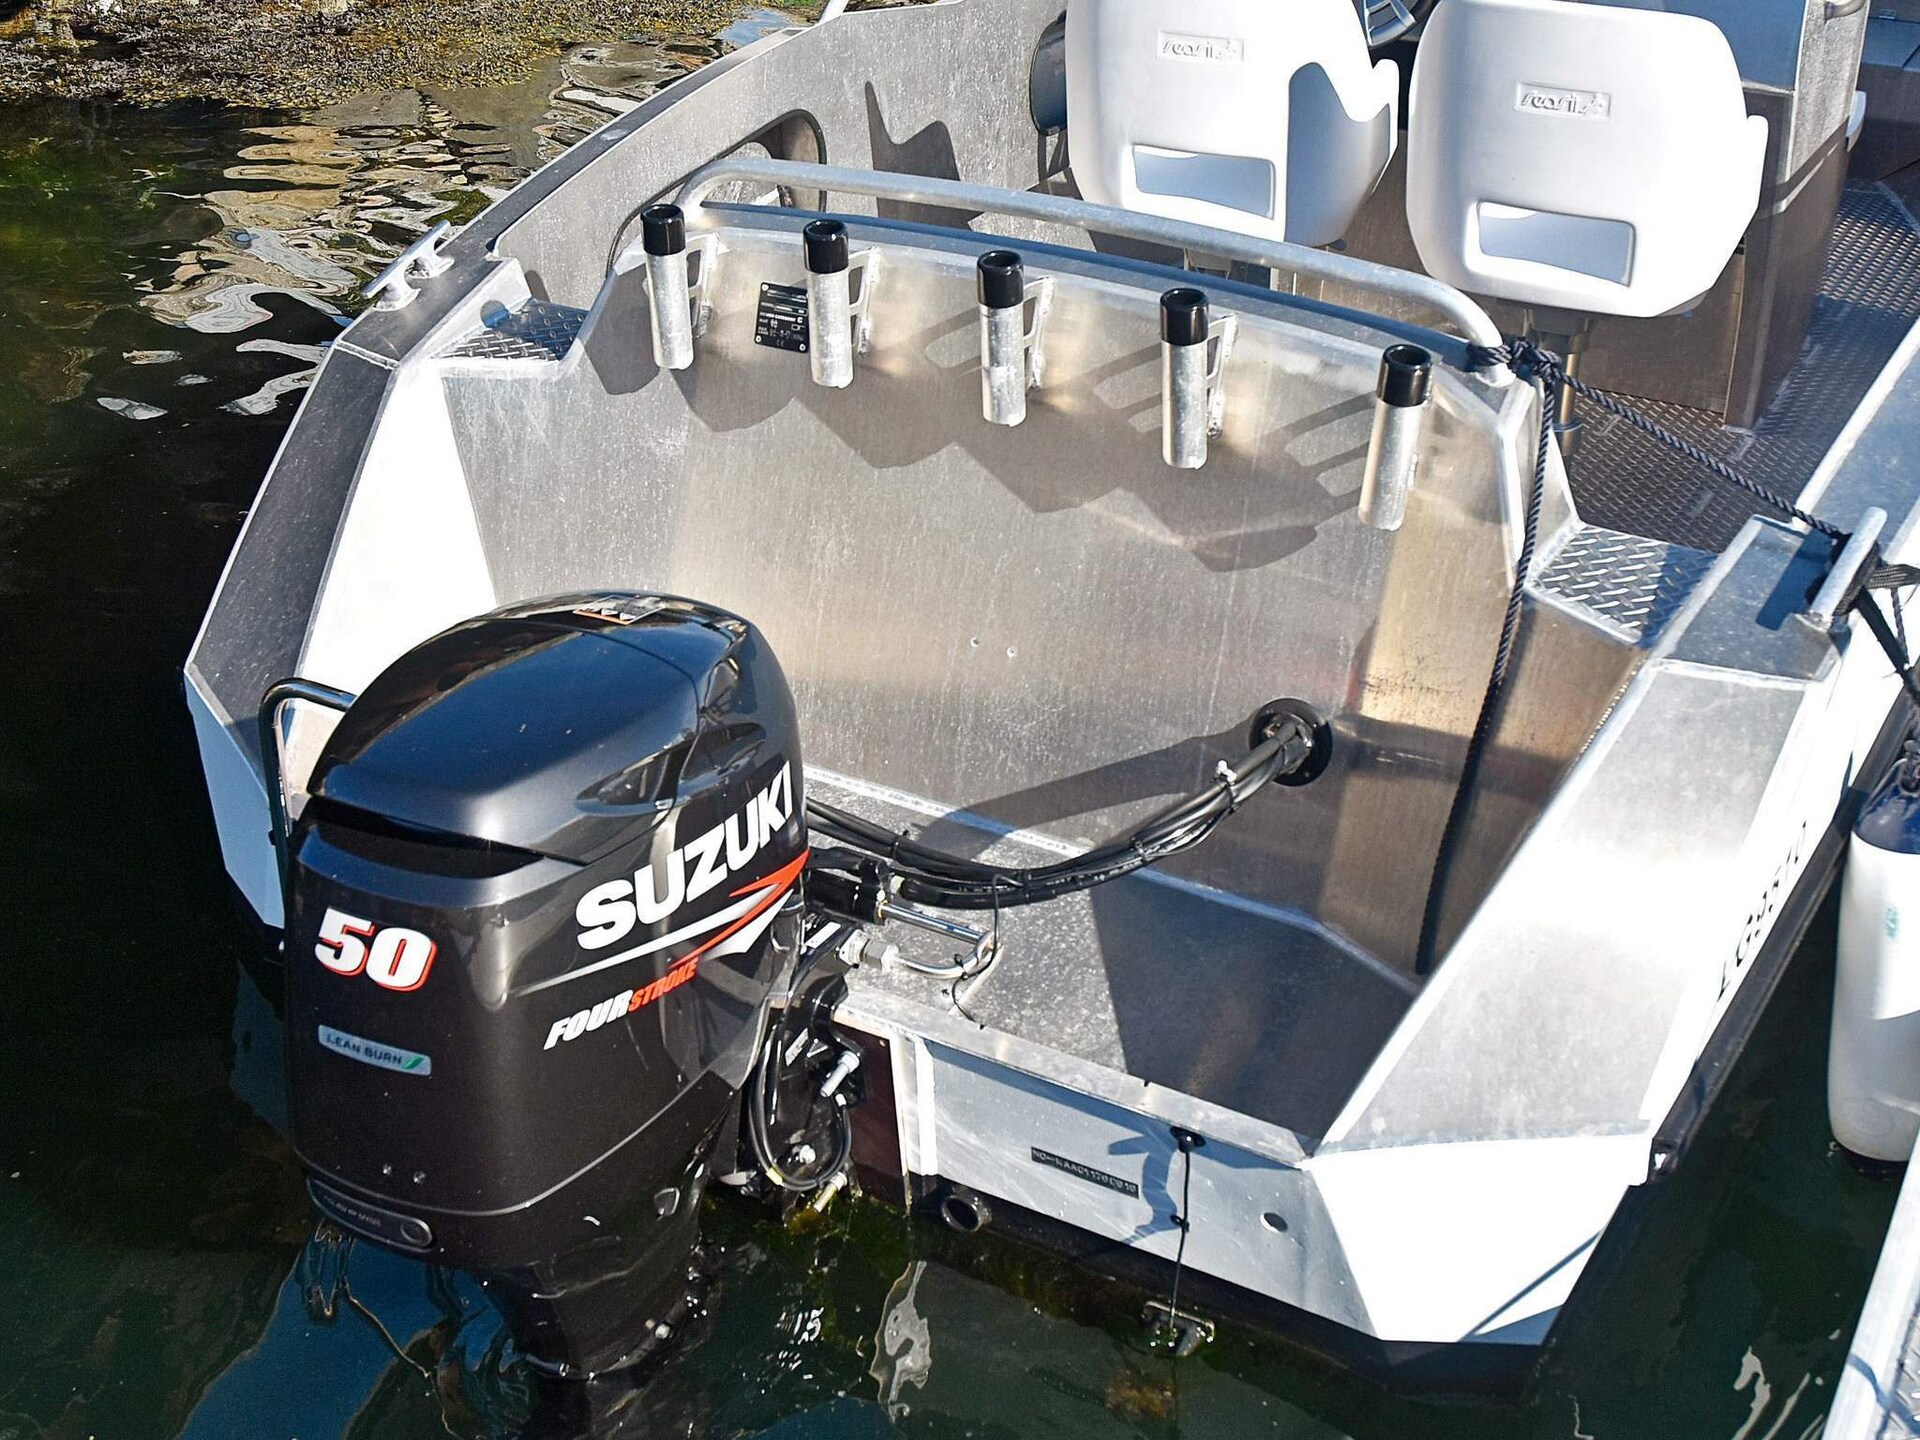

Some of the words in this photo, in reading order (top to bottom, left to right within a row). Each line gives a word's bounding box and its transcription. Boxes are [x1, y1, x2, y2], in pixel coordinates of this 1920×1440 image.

[576, 760, 793, 950] SUZUKI
[314, 907, 438, 992] 50
[326, 1032, 361, 1055] LEAN
[363, 1046, 403, 1066] BURN
